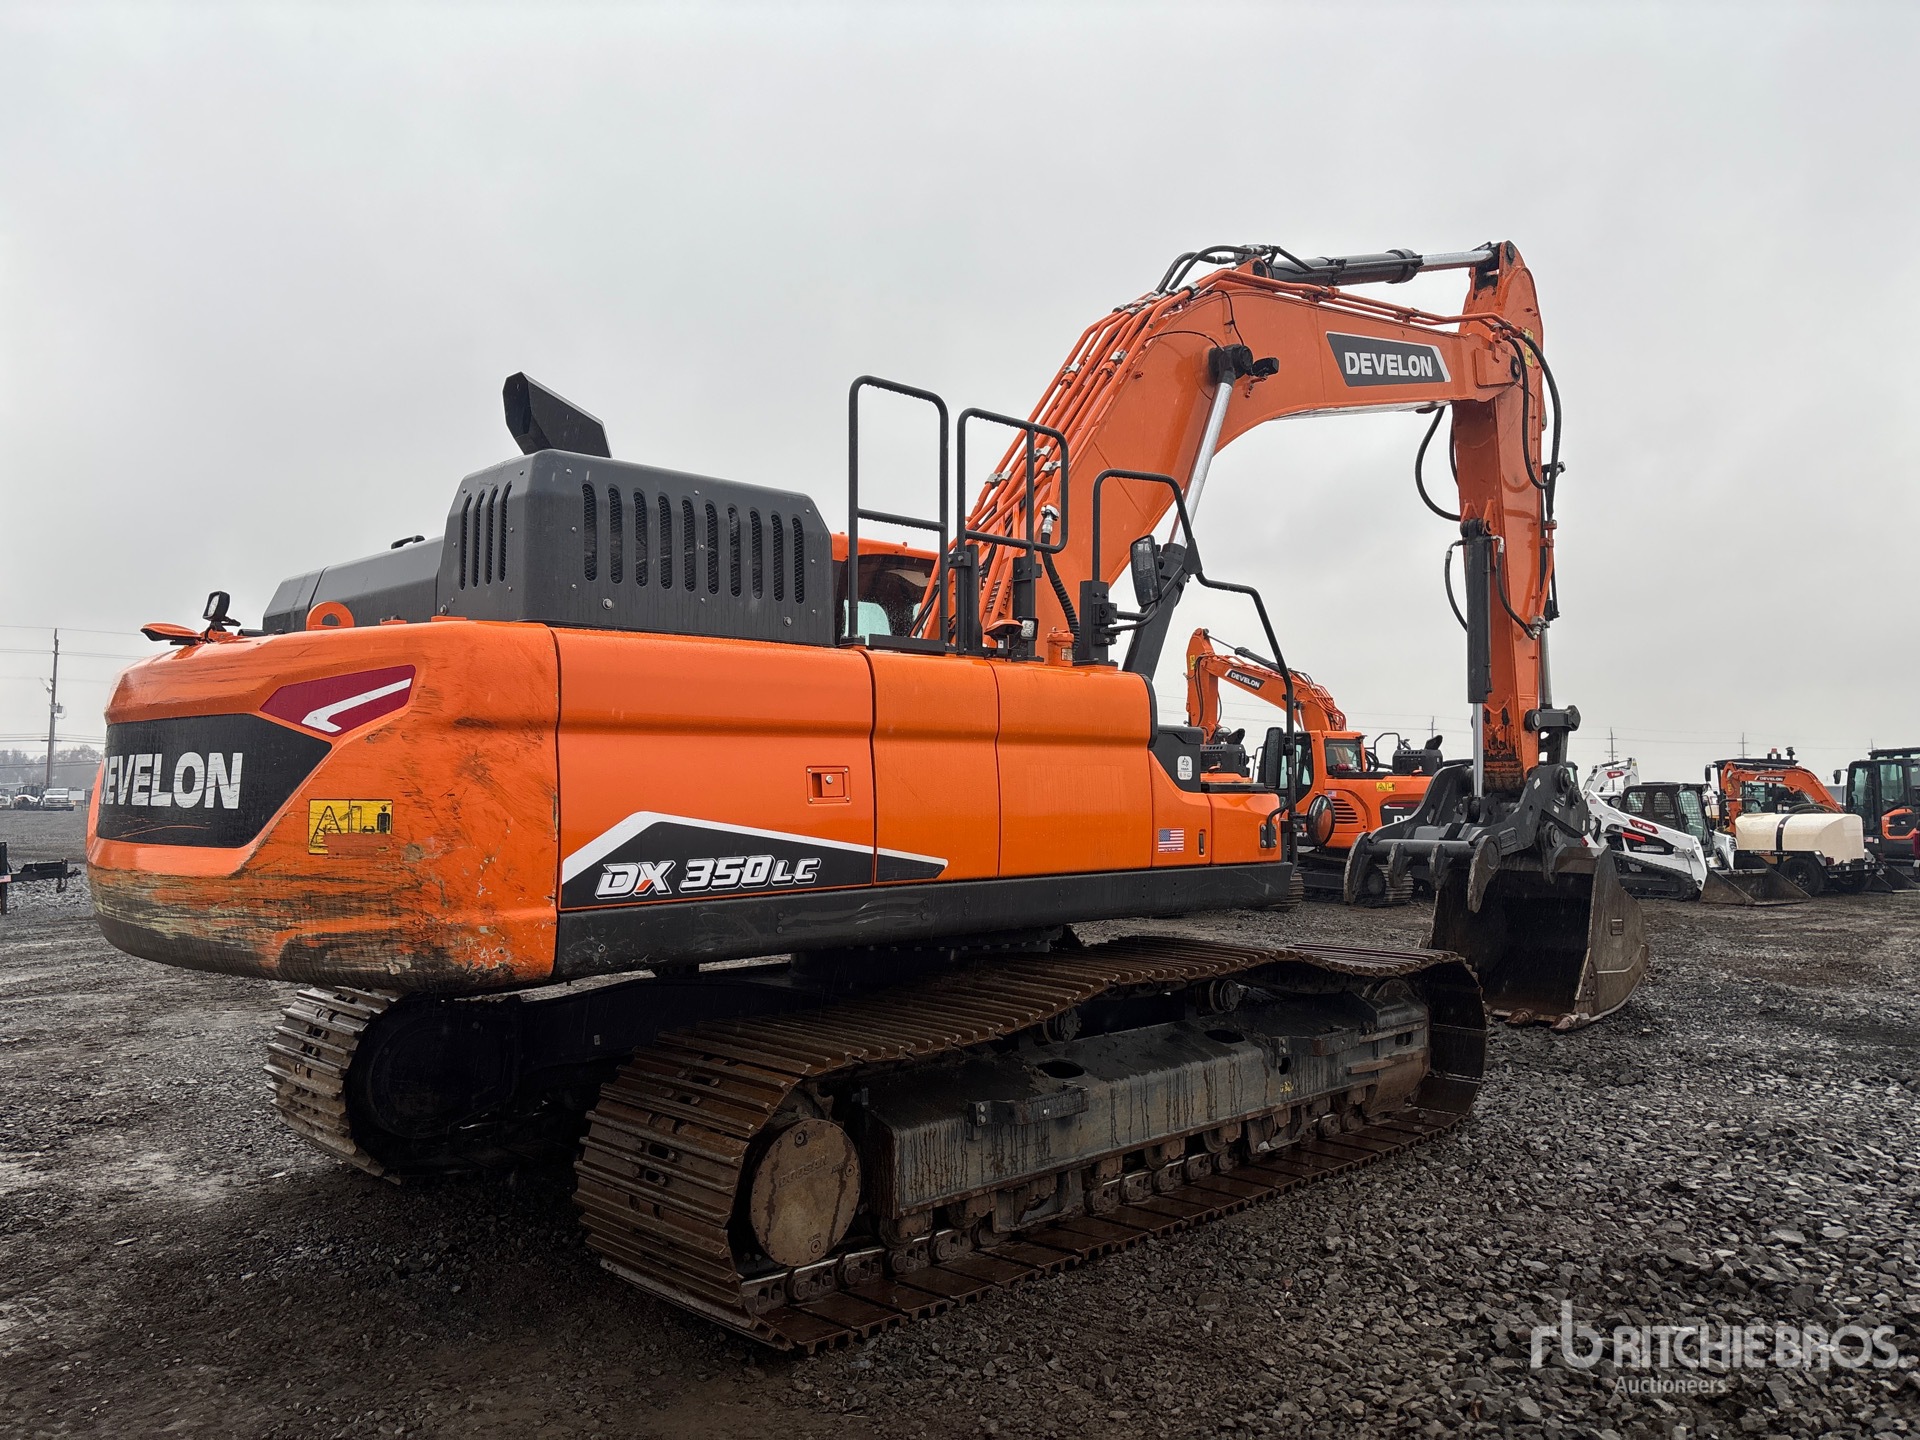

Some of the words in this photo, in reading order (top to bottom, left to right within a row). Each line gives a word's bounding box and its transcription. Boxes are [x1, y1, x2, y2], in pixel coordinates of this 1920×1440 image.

[1344, 352, 1433, 377] DEVELON
[1231, 672, 1261, 688] DEVELON
[100, 751, 243, 809] DEVELON
[595, 860, 676, 899] DX
